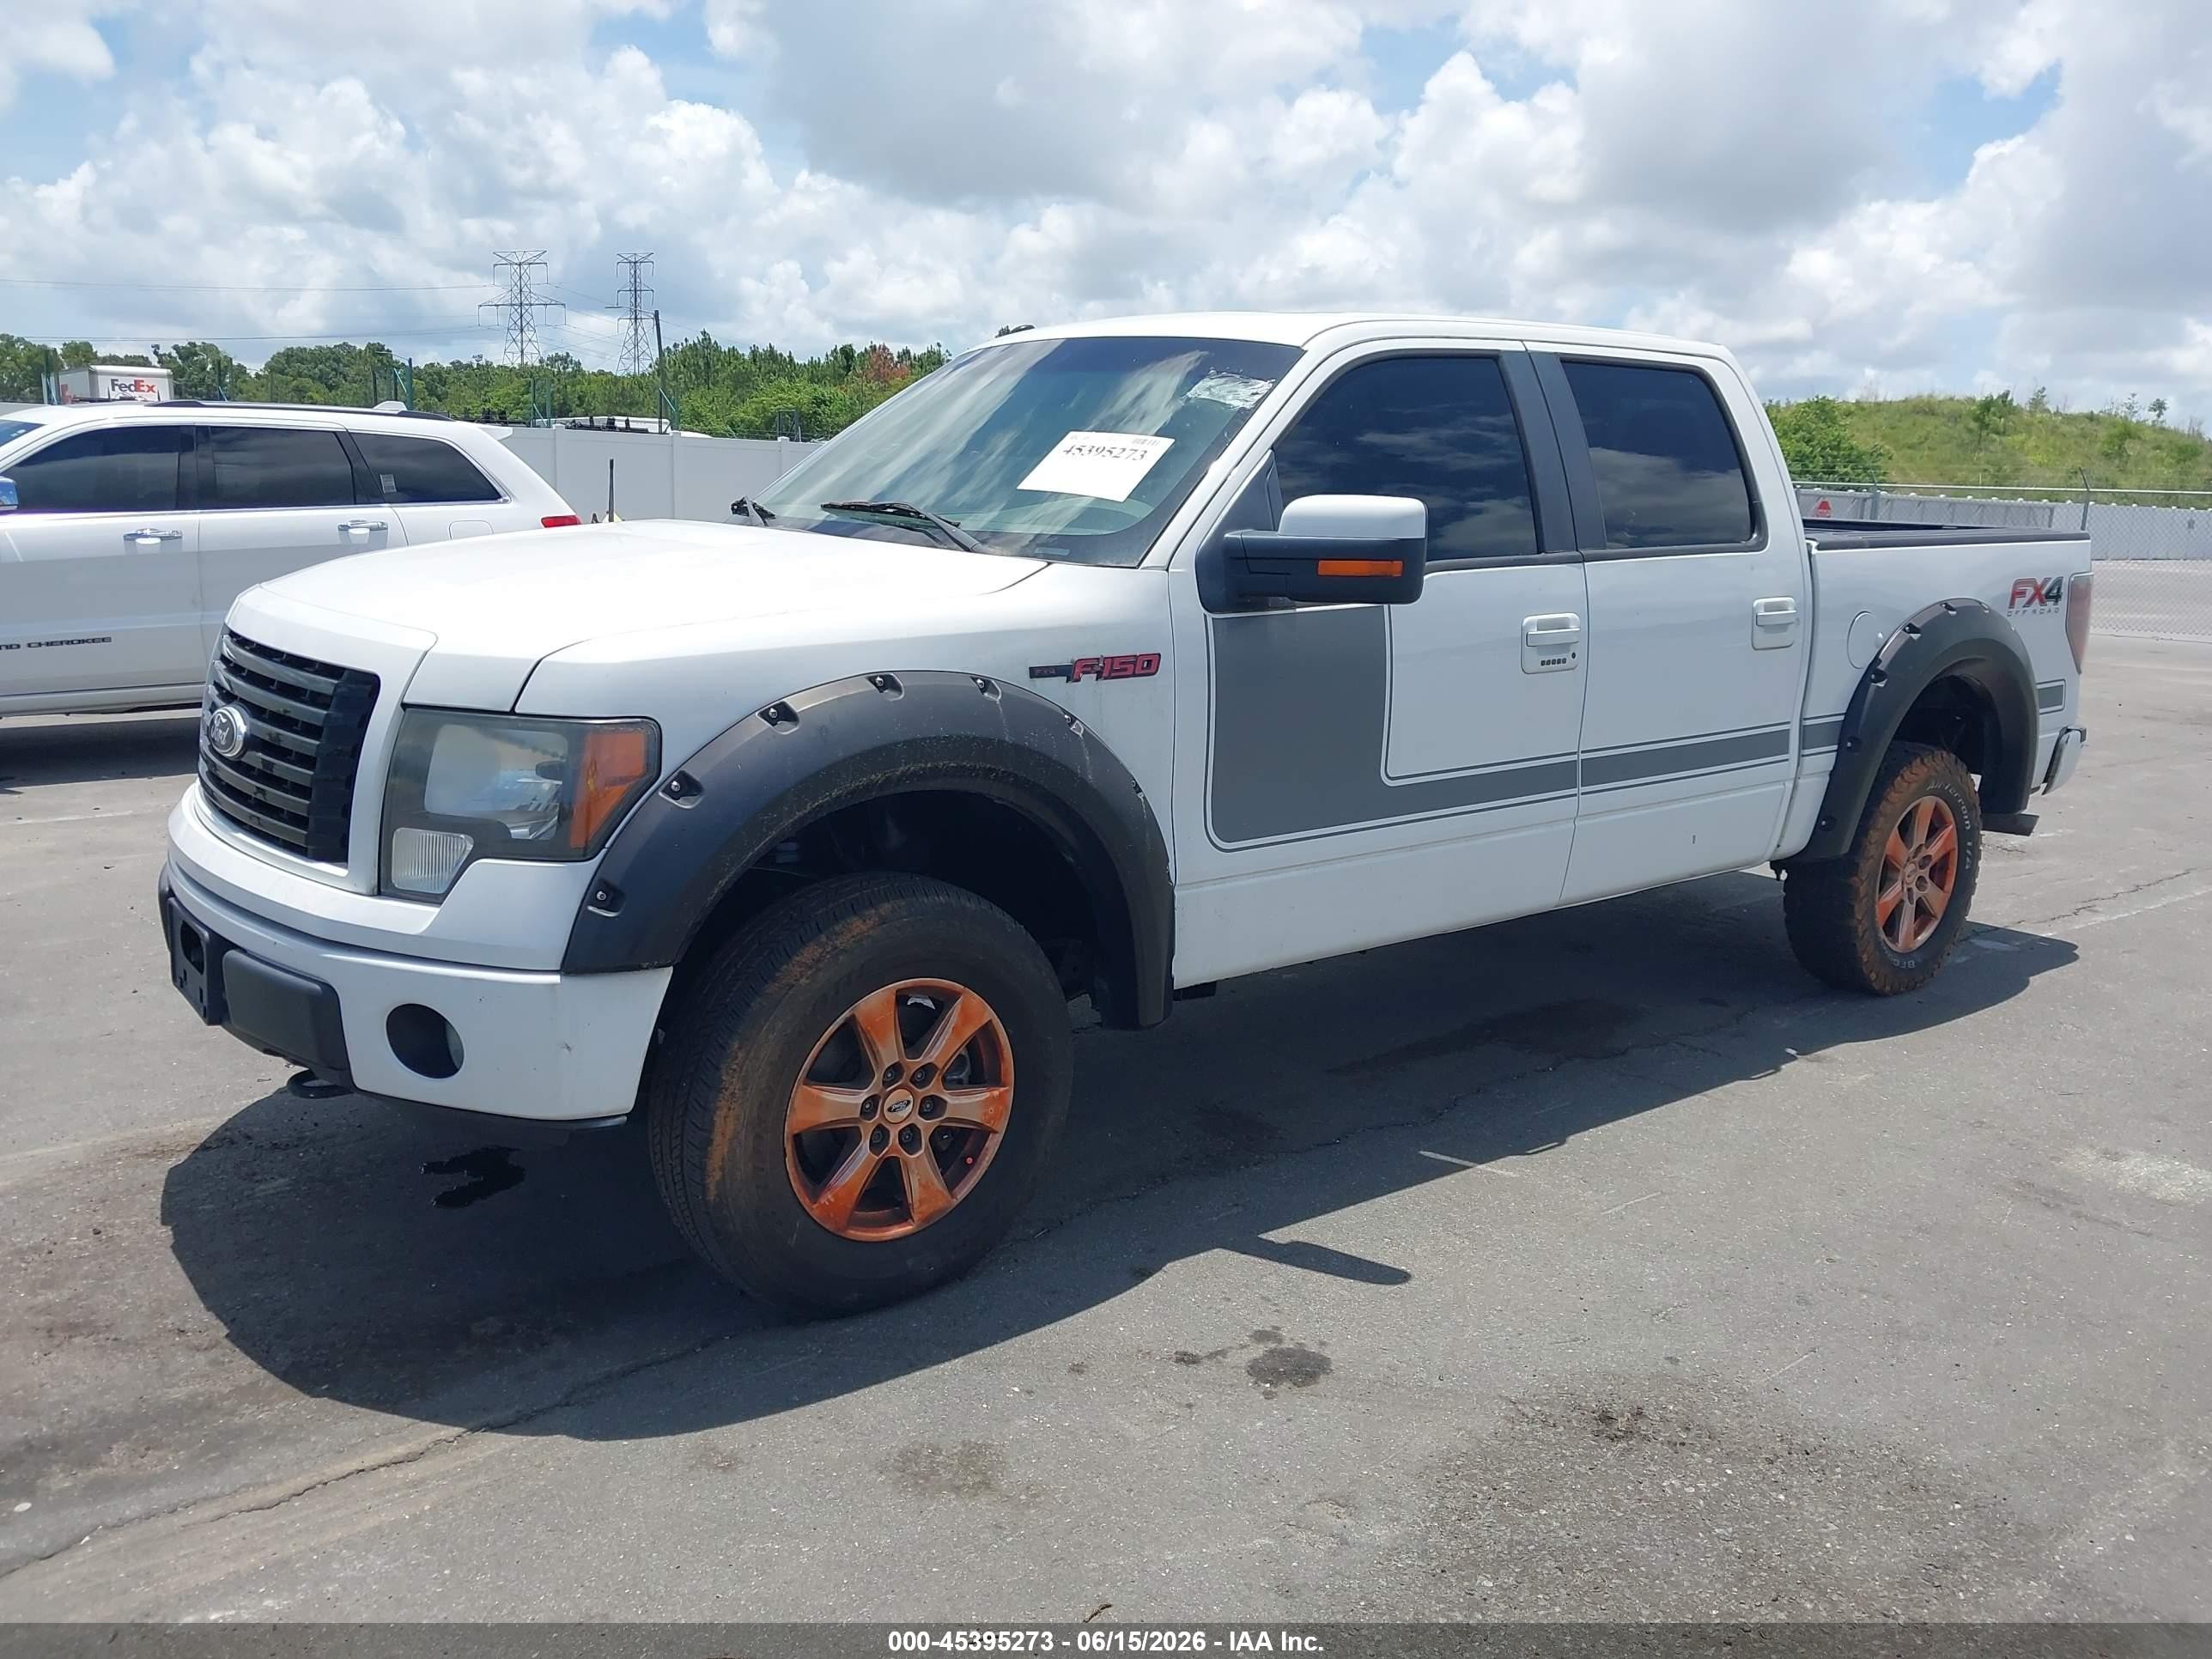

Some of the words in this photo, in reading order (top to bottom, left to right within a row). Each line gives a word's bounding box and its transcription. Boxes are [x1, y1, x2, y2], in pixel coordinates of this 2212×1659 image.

[110, 378, 156, 393] FedEx
[1063, 445, 1148, 461] 45395273
[2008, 576, 2063, 610] FX4
[27, 636, 112, 648] CHEROKEE
[211, 713, 229, 745] Ford
